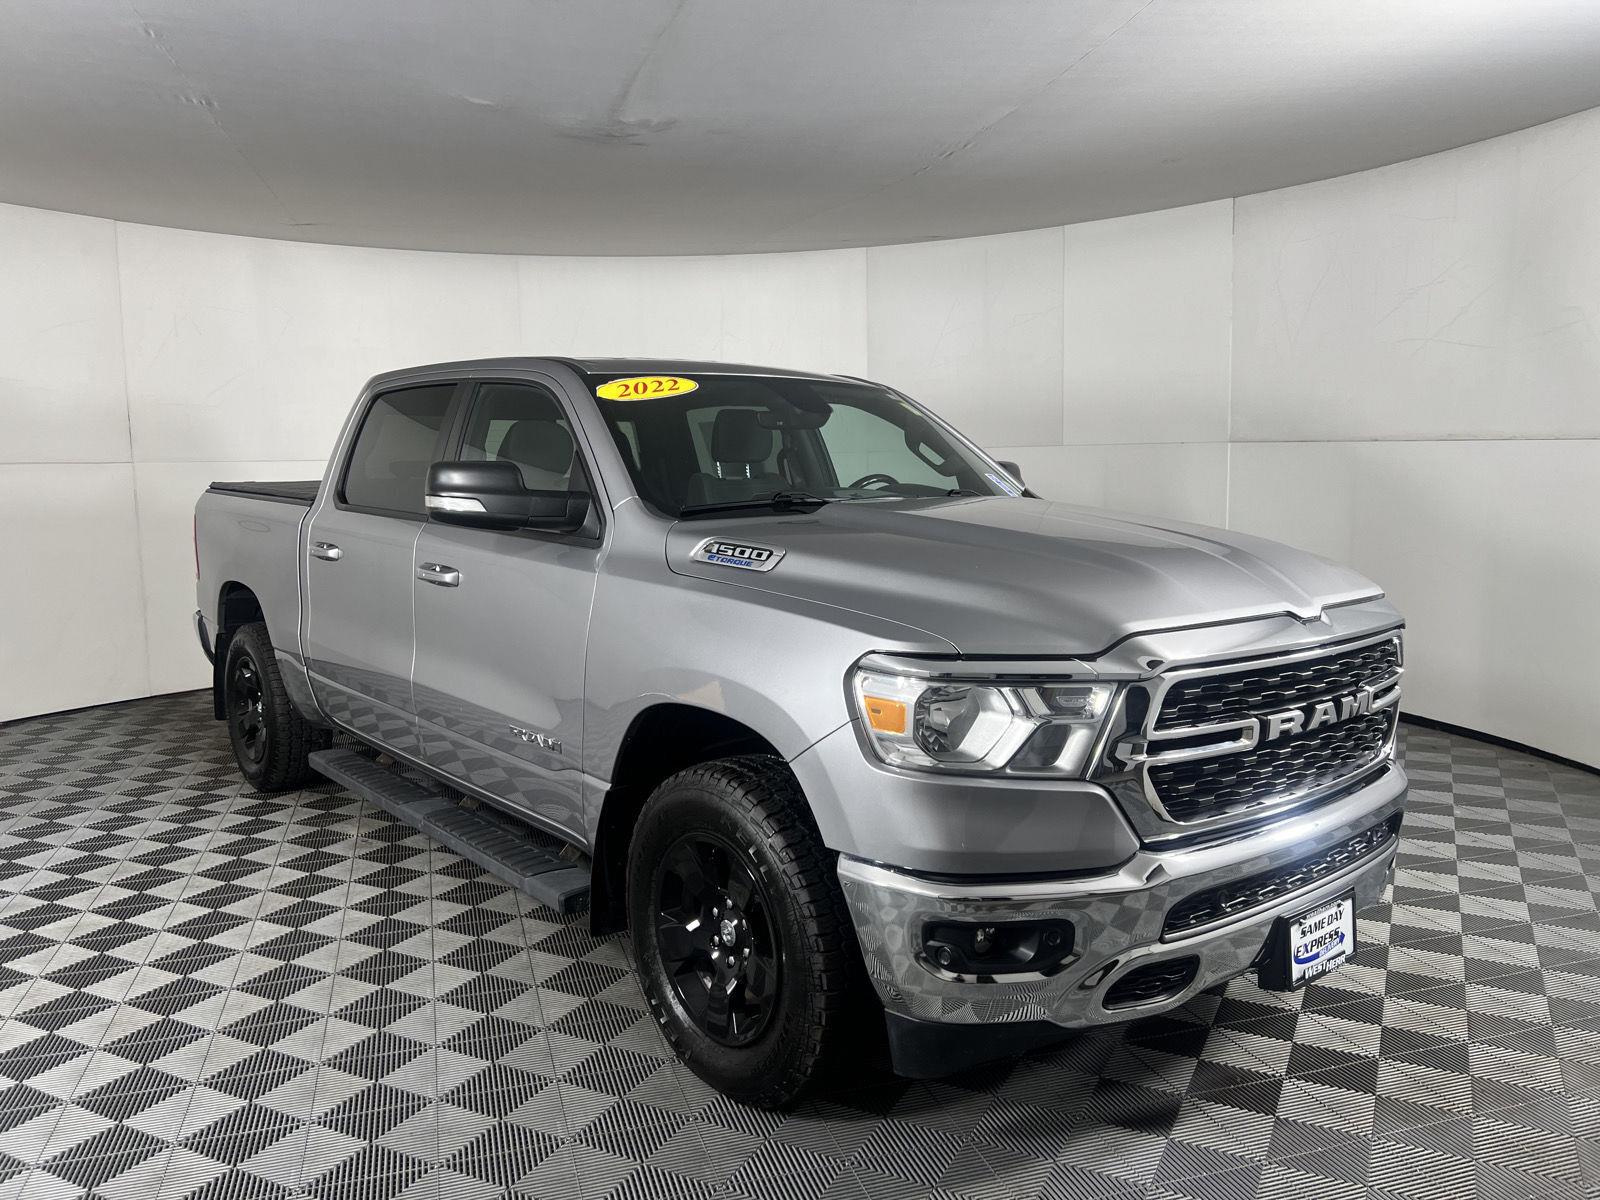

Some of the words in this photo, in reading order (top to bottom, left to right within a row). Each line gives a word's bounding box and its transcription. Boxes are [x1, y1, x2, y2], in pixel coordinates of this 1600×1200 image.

[617, 379, 680, 398] 2022
[704, 542, 770, 561] 1500
[1266, 691, 1369, 741] RAM
[1300, 918, 1327, 939] SAME
[1327, 907, 1345, 927] DAY
[1296, 926, 1341, 958] EXPRESS
